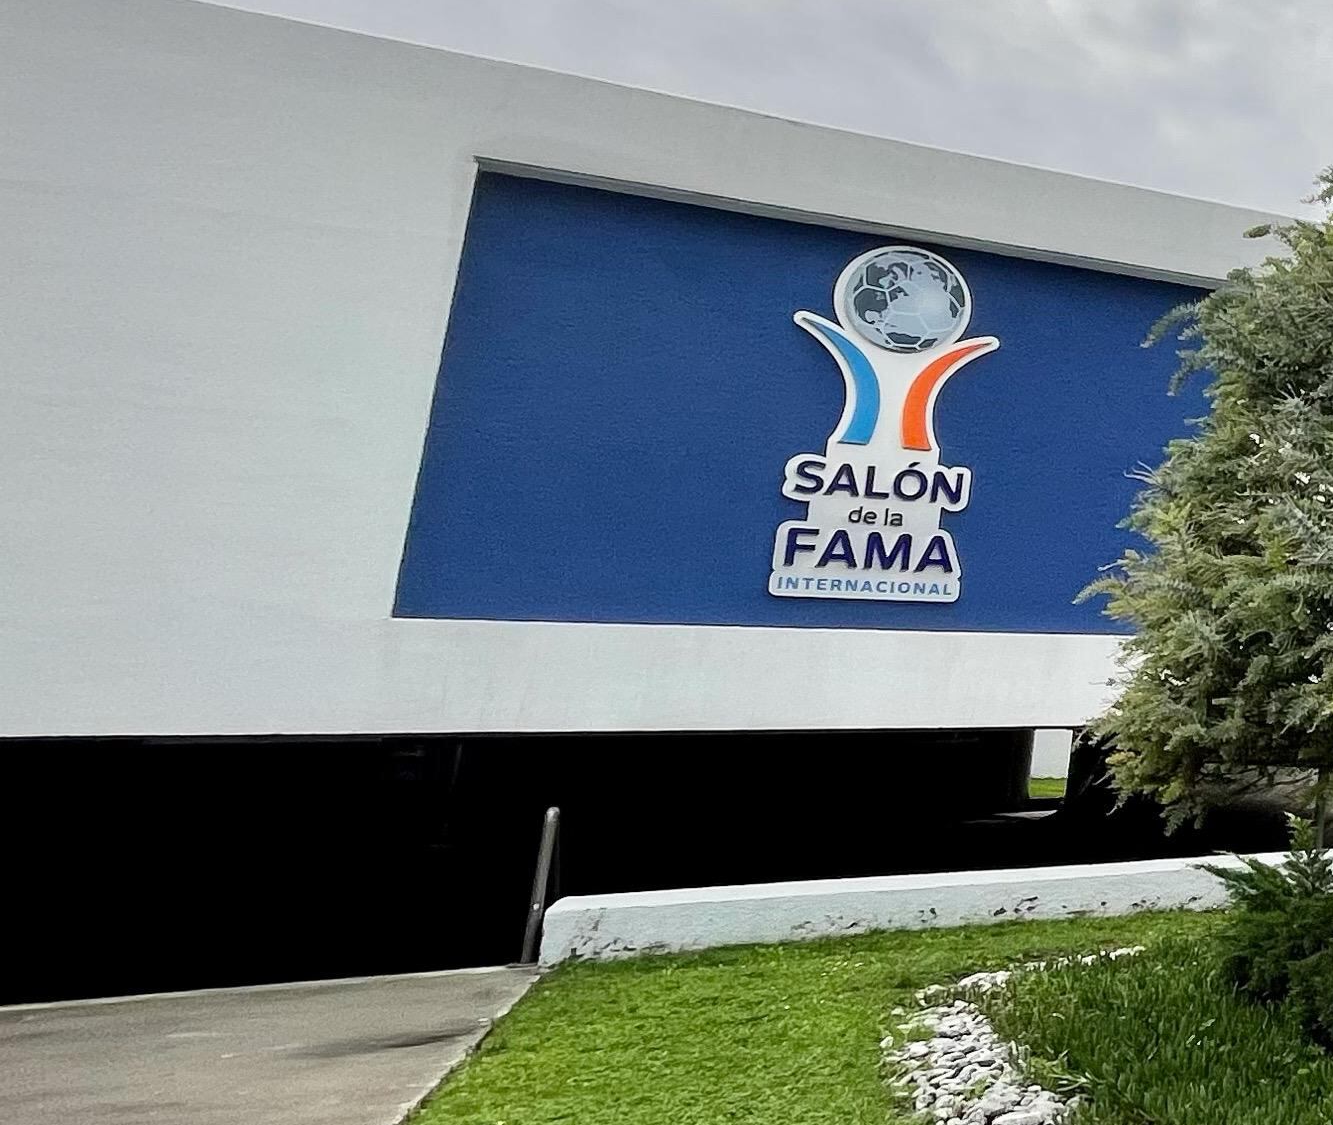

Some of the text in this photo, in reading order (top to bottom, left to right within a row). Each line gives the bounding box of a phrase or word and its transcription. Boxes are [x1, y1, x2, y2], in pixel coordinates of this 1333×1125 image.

[793, 460, 964, 505] SALÓN
[848, 506, 903, 527] de la
[783, 527, 954, 573] FAMA
[776, 576, 952, 597] INTERNACIONAL
